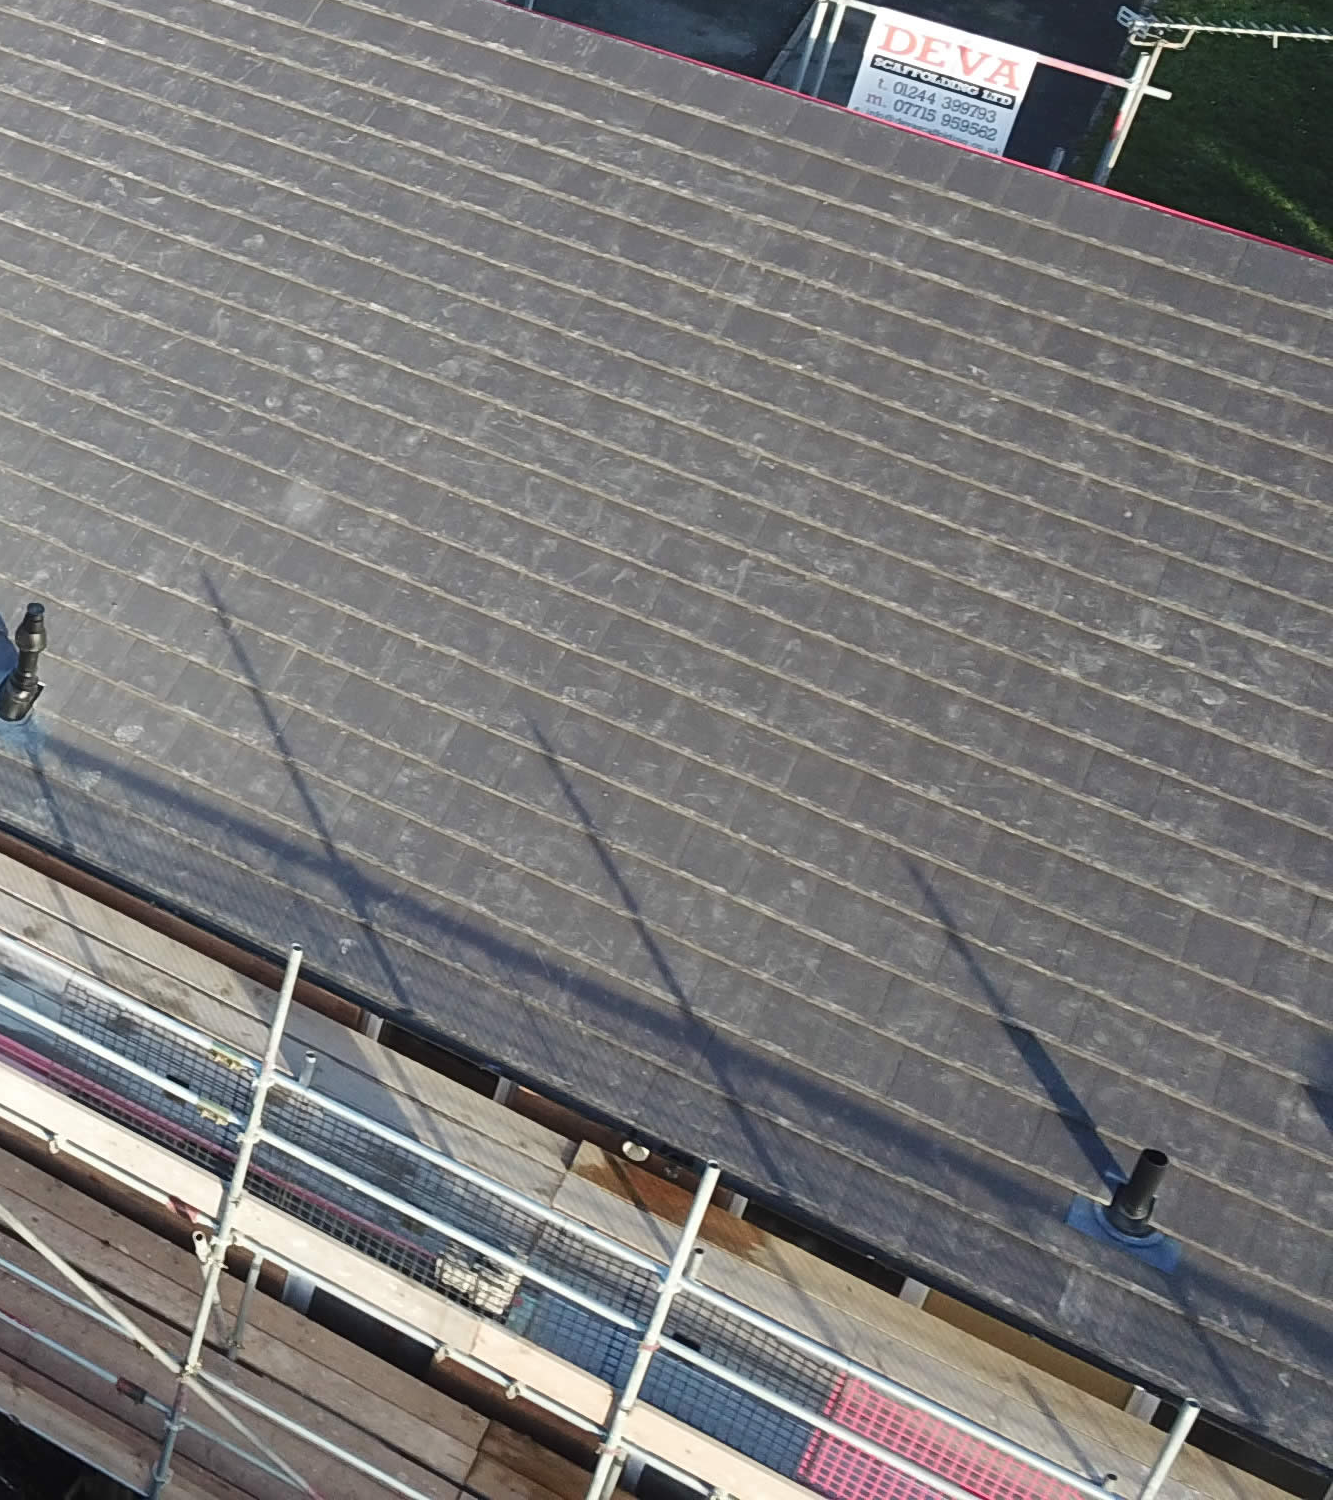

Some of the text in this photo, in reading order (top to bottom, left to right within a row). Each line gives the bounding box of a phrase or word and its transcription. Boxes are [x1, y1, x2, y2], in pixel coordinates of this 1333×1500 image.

[877, 24, 1020, 91] DEVA
[874, 57, 1013, 106] SCAFFOLDING LTD
[893, 81, 936, 105] 01244
[941, 96, 997, 123] 399793
[894, 99, 936, 122] 07715
[941, 114, 998, 142] 959562
